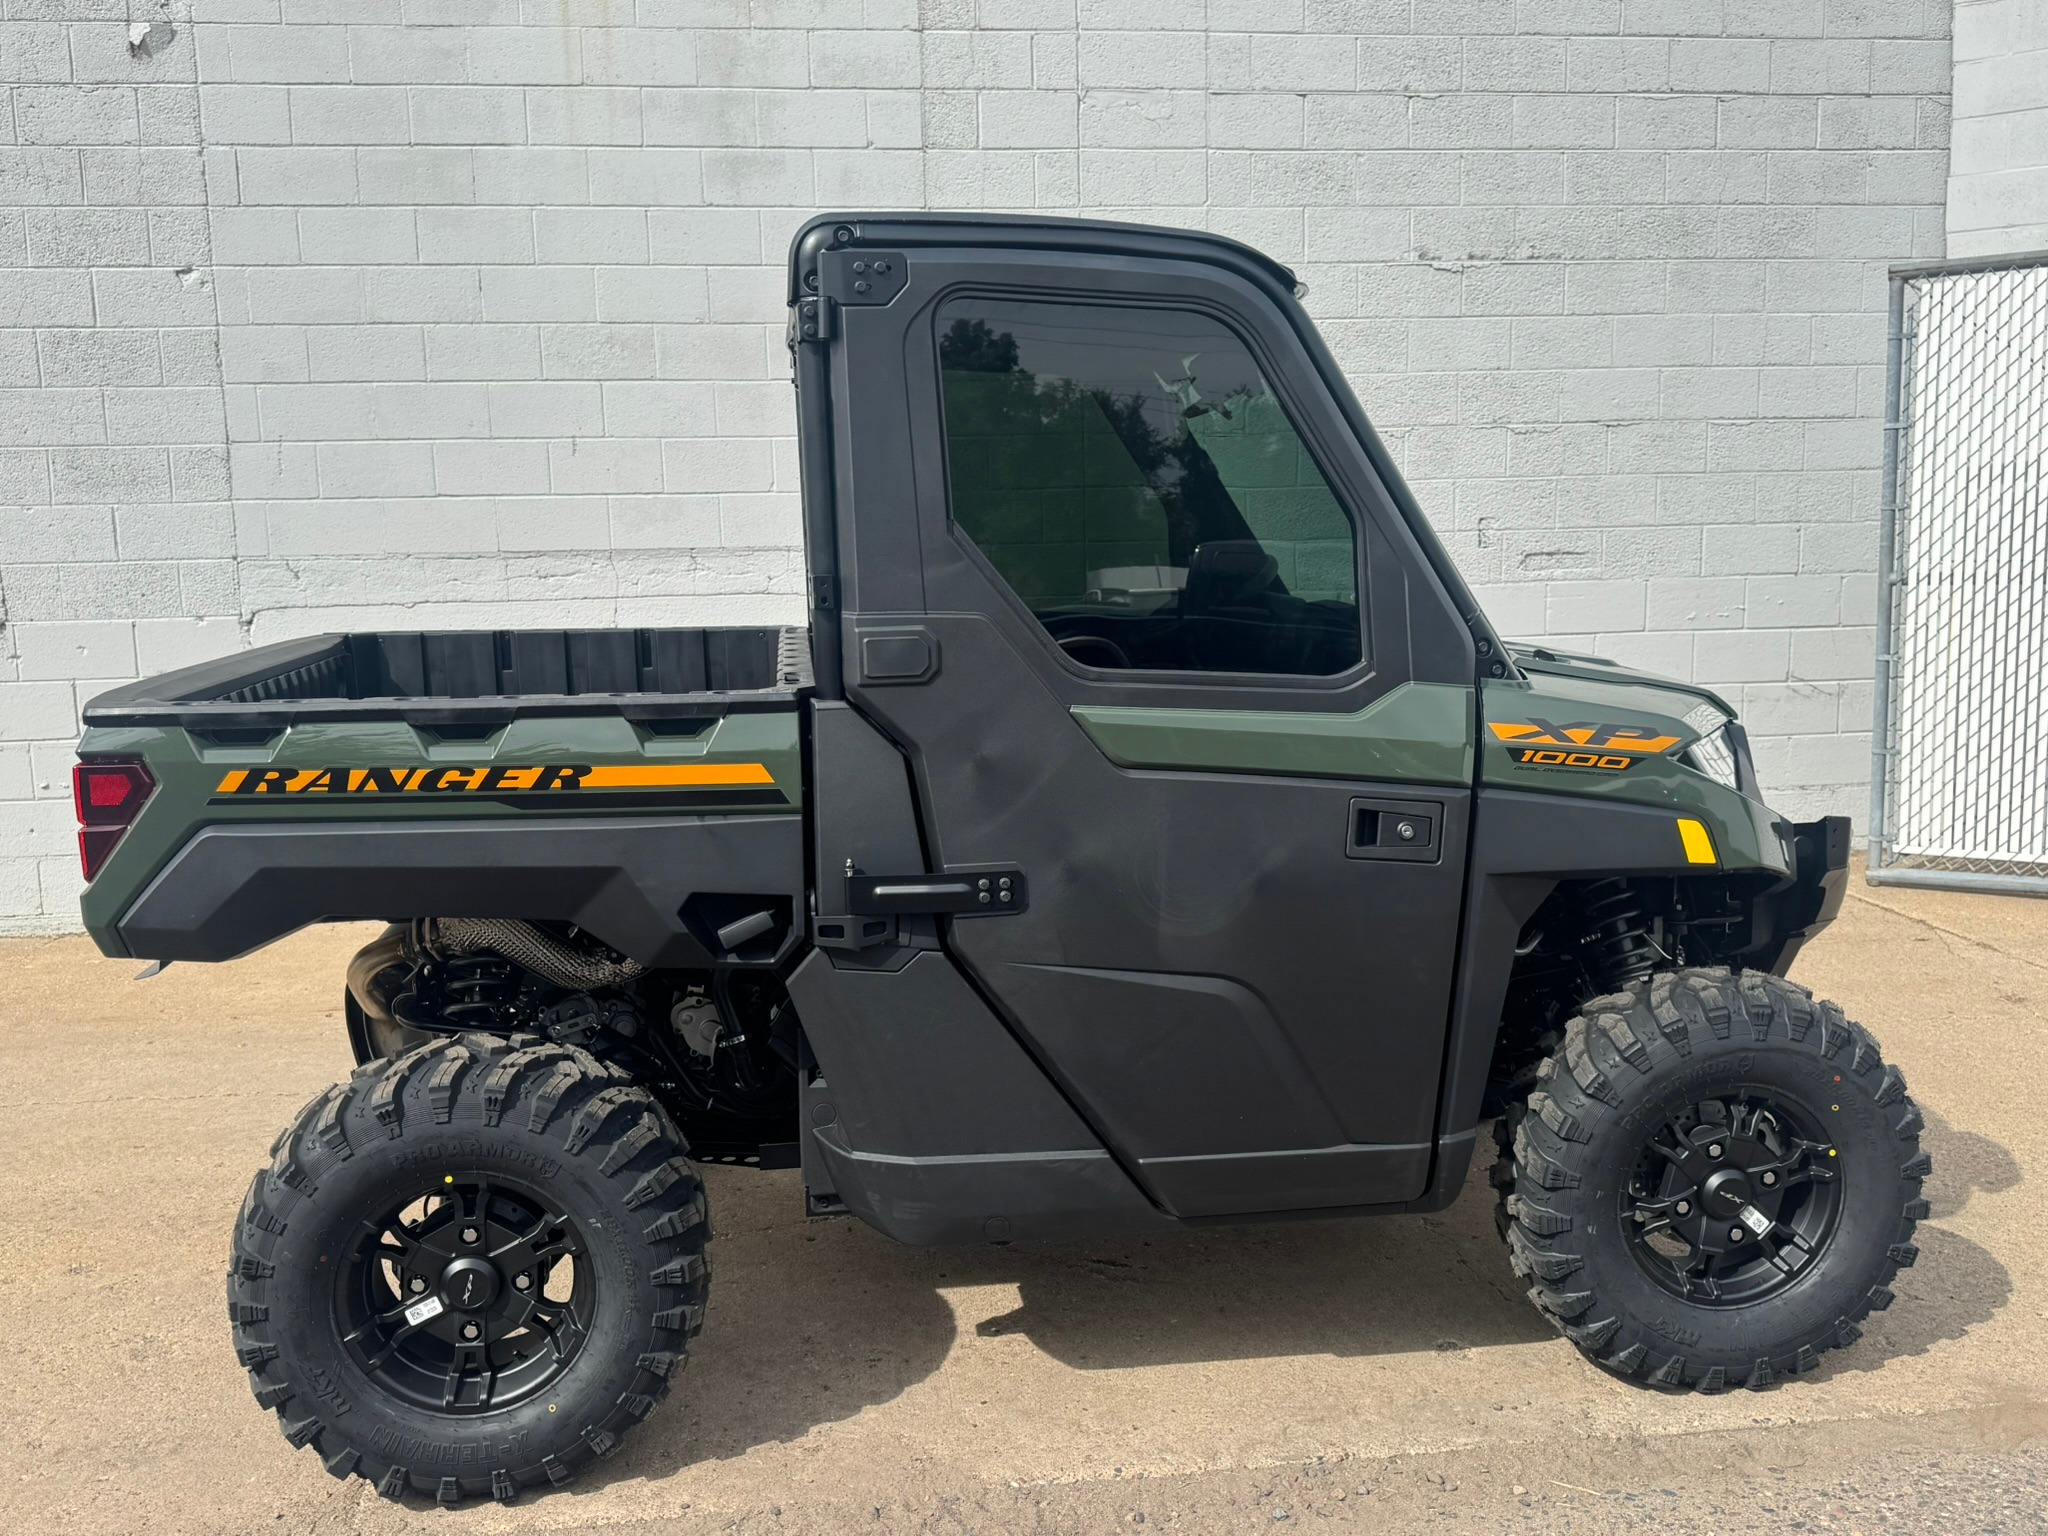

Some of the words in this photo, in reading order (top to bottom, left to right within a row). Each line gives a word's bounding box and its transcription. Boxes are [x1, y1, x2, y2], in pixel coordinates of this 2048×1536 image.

[1504, 717, 1663, 745] XP
[1521, 750, 1631, 769] 1000
[1543, 767, 1595, 775] OVERHEAD
[233, 765, 593, 794] RANGER
[391, 1142, 442, 1169] PRO
[447, 1140, 537, 1168] ARMOR
[368, 1424, 532, 1465] X-TERRAIN
